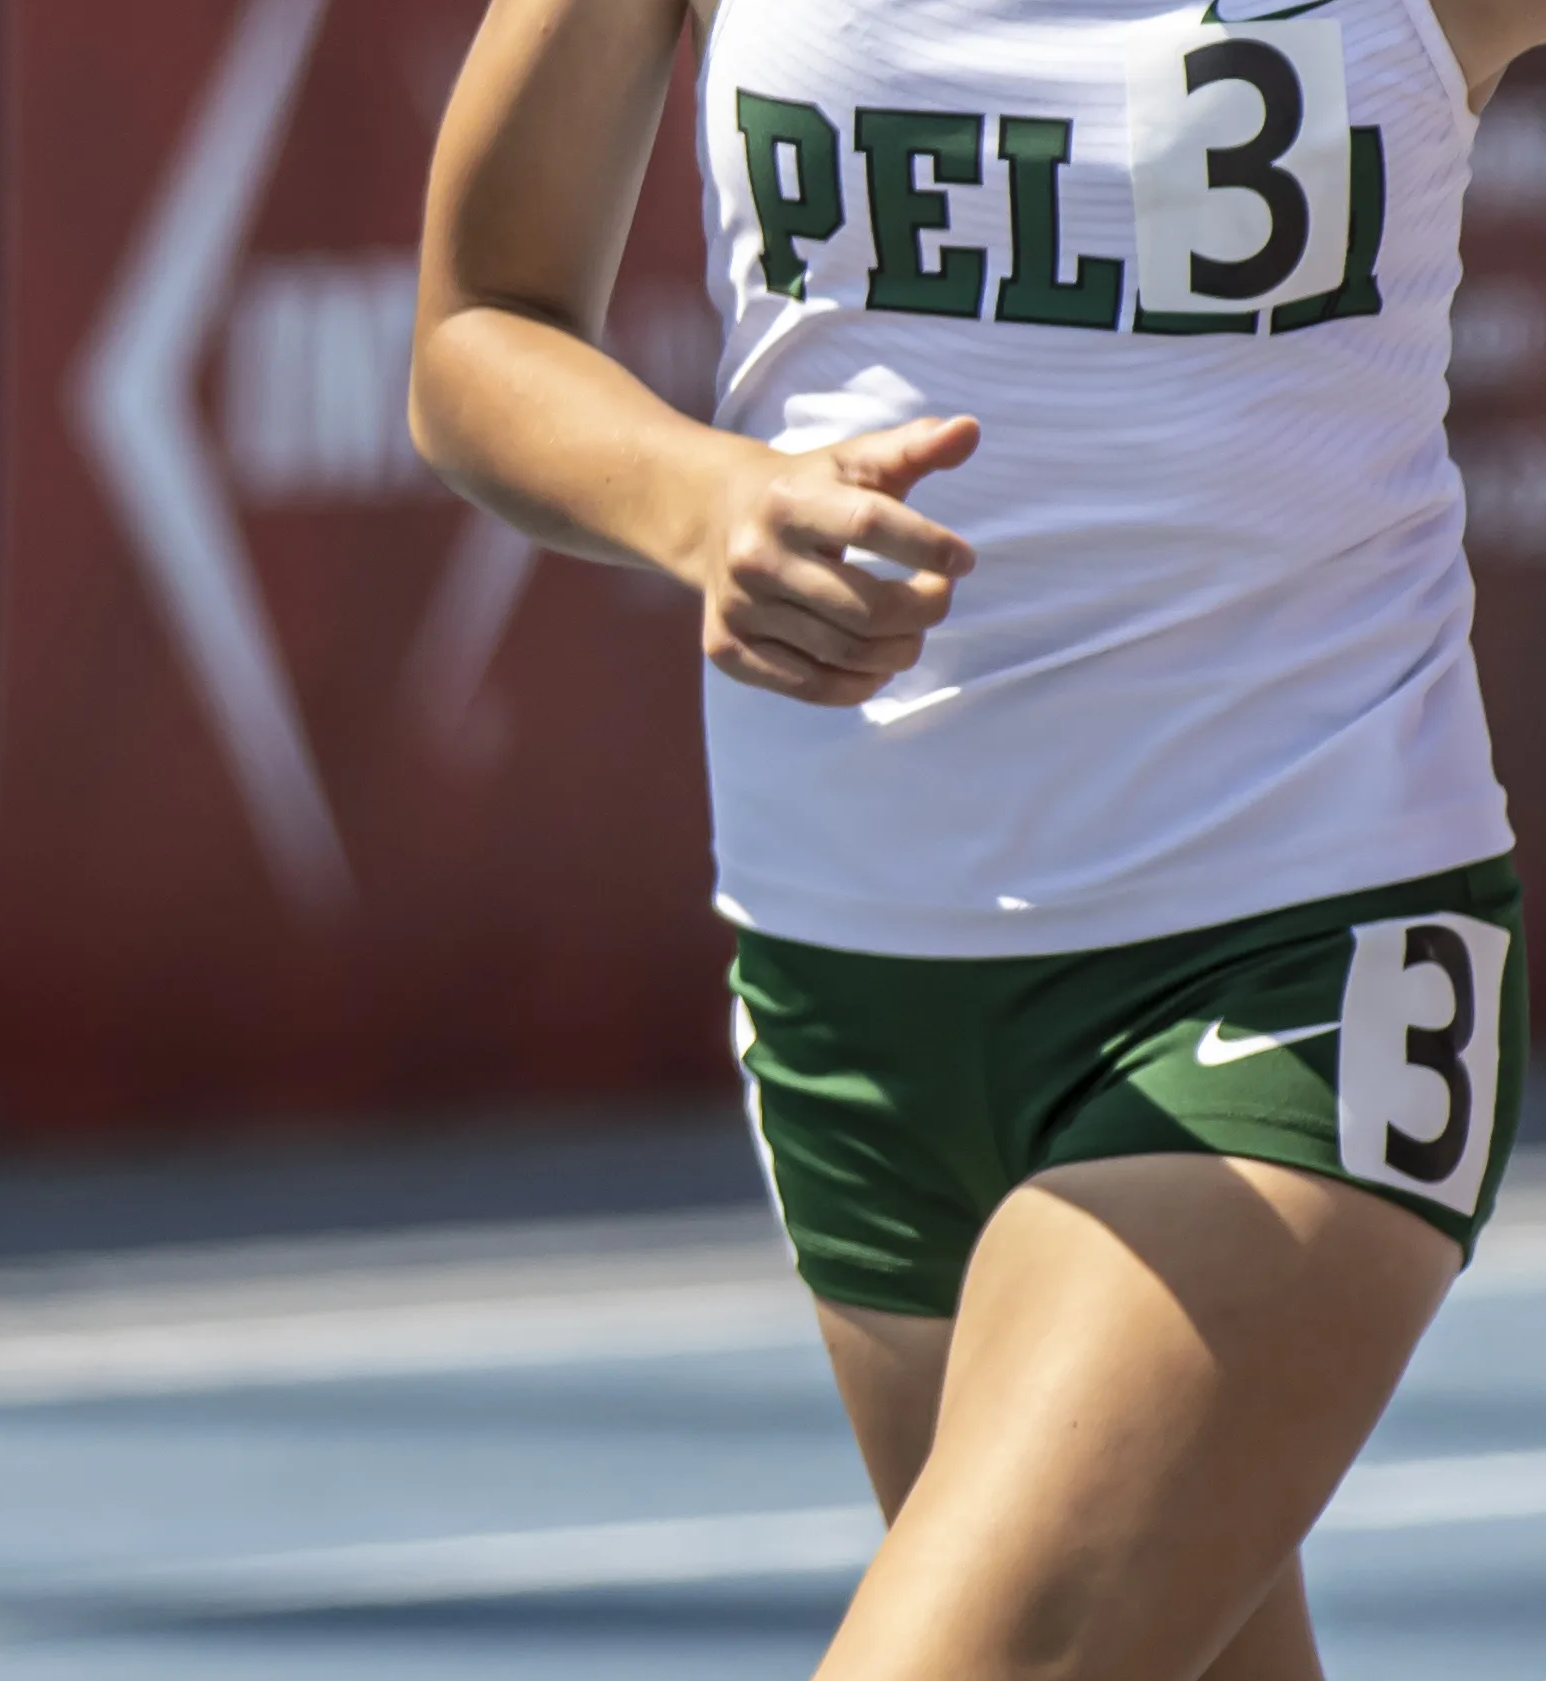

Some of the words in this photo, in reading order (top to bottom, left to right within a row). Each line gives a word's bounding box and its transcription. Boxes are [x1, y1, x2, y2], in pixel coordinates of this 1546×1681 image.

[735, 85, 1385, 335] PEL
[1183, 37, 1310, 301] 3
[1383, 923, 1475, 1184] 3
